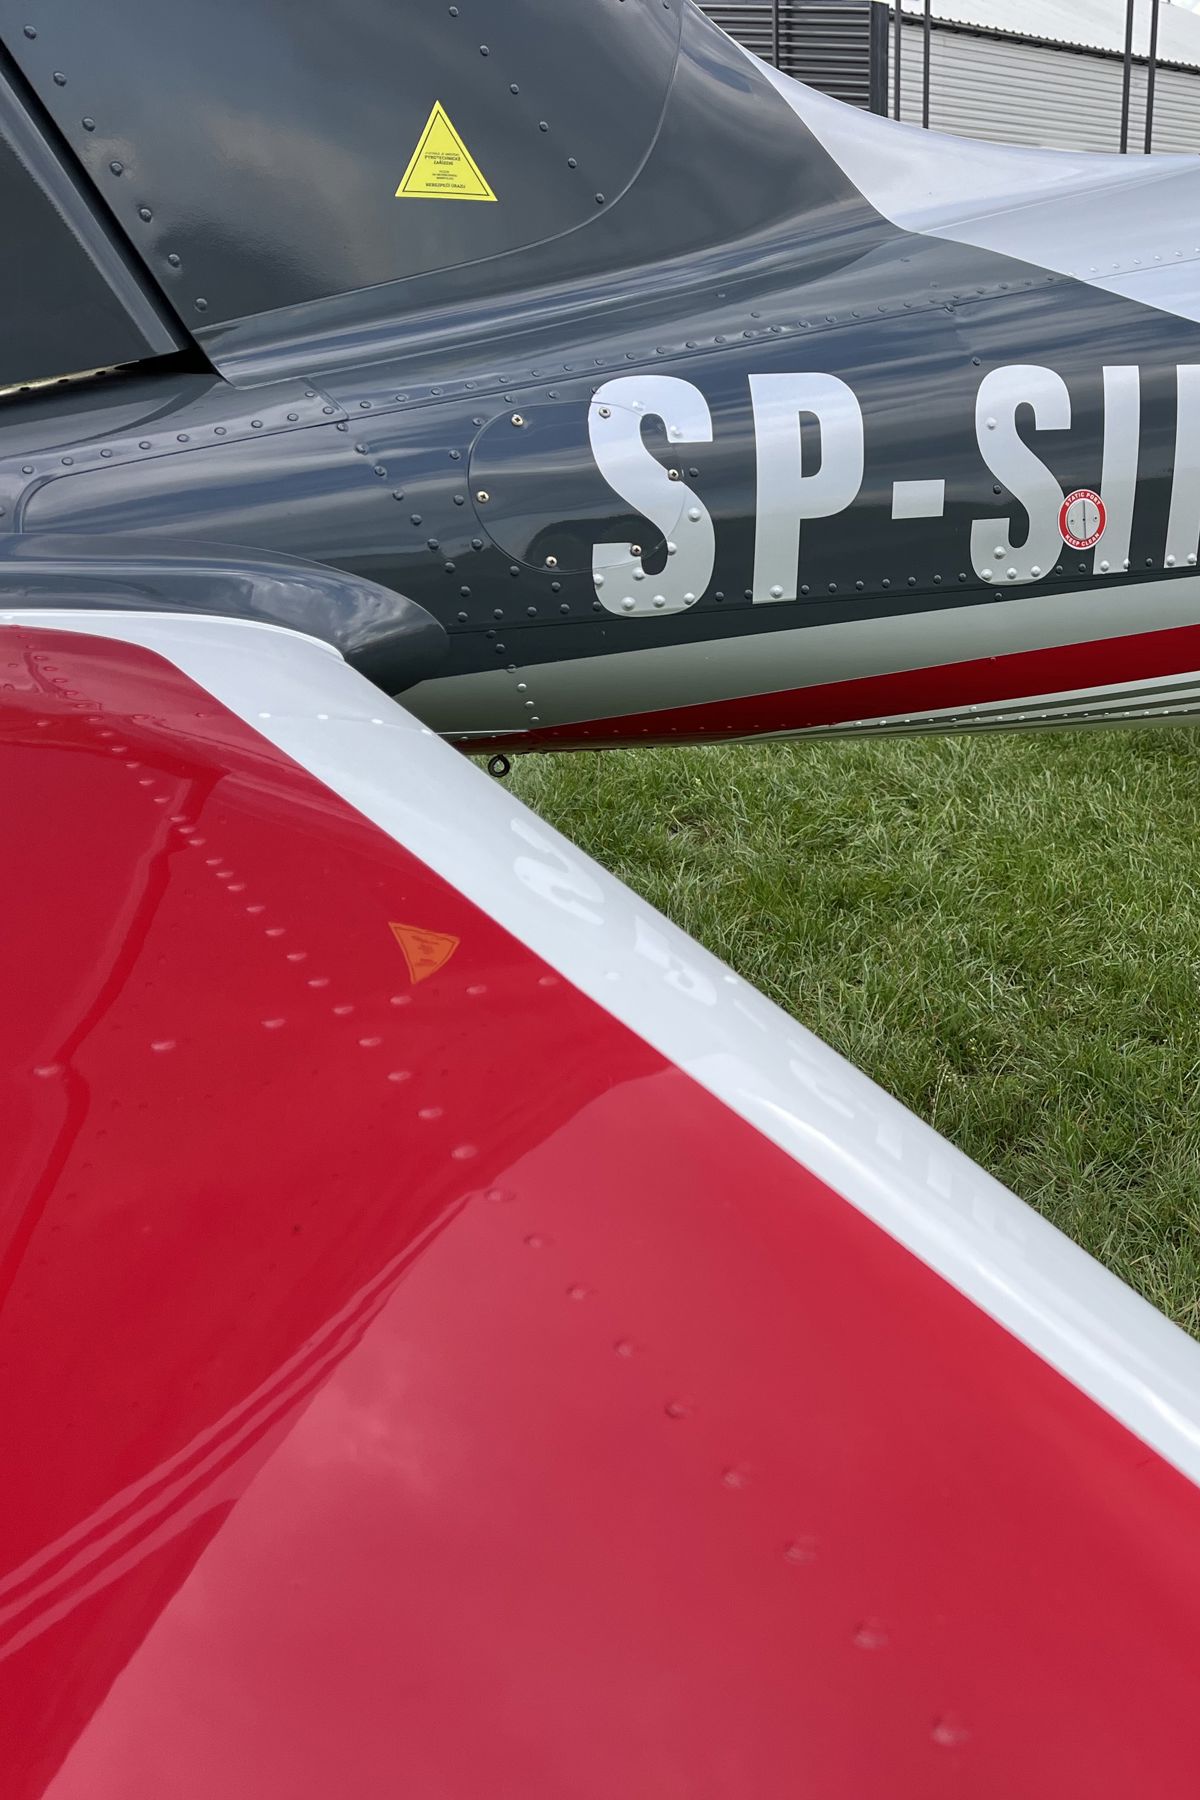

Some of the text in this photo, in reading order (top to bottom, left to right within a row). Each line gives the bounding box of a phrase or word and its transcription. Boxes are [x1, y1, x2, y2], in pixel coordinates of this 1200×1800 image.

[1065, 492, 1101, 507] STATIC PORT
[1065, 533, 1100, 546] KEEP CLEAN
